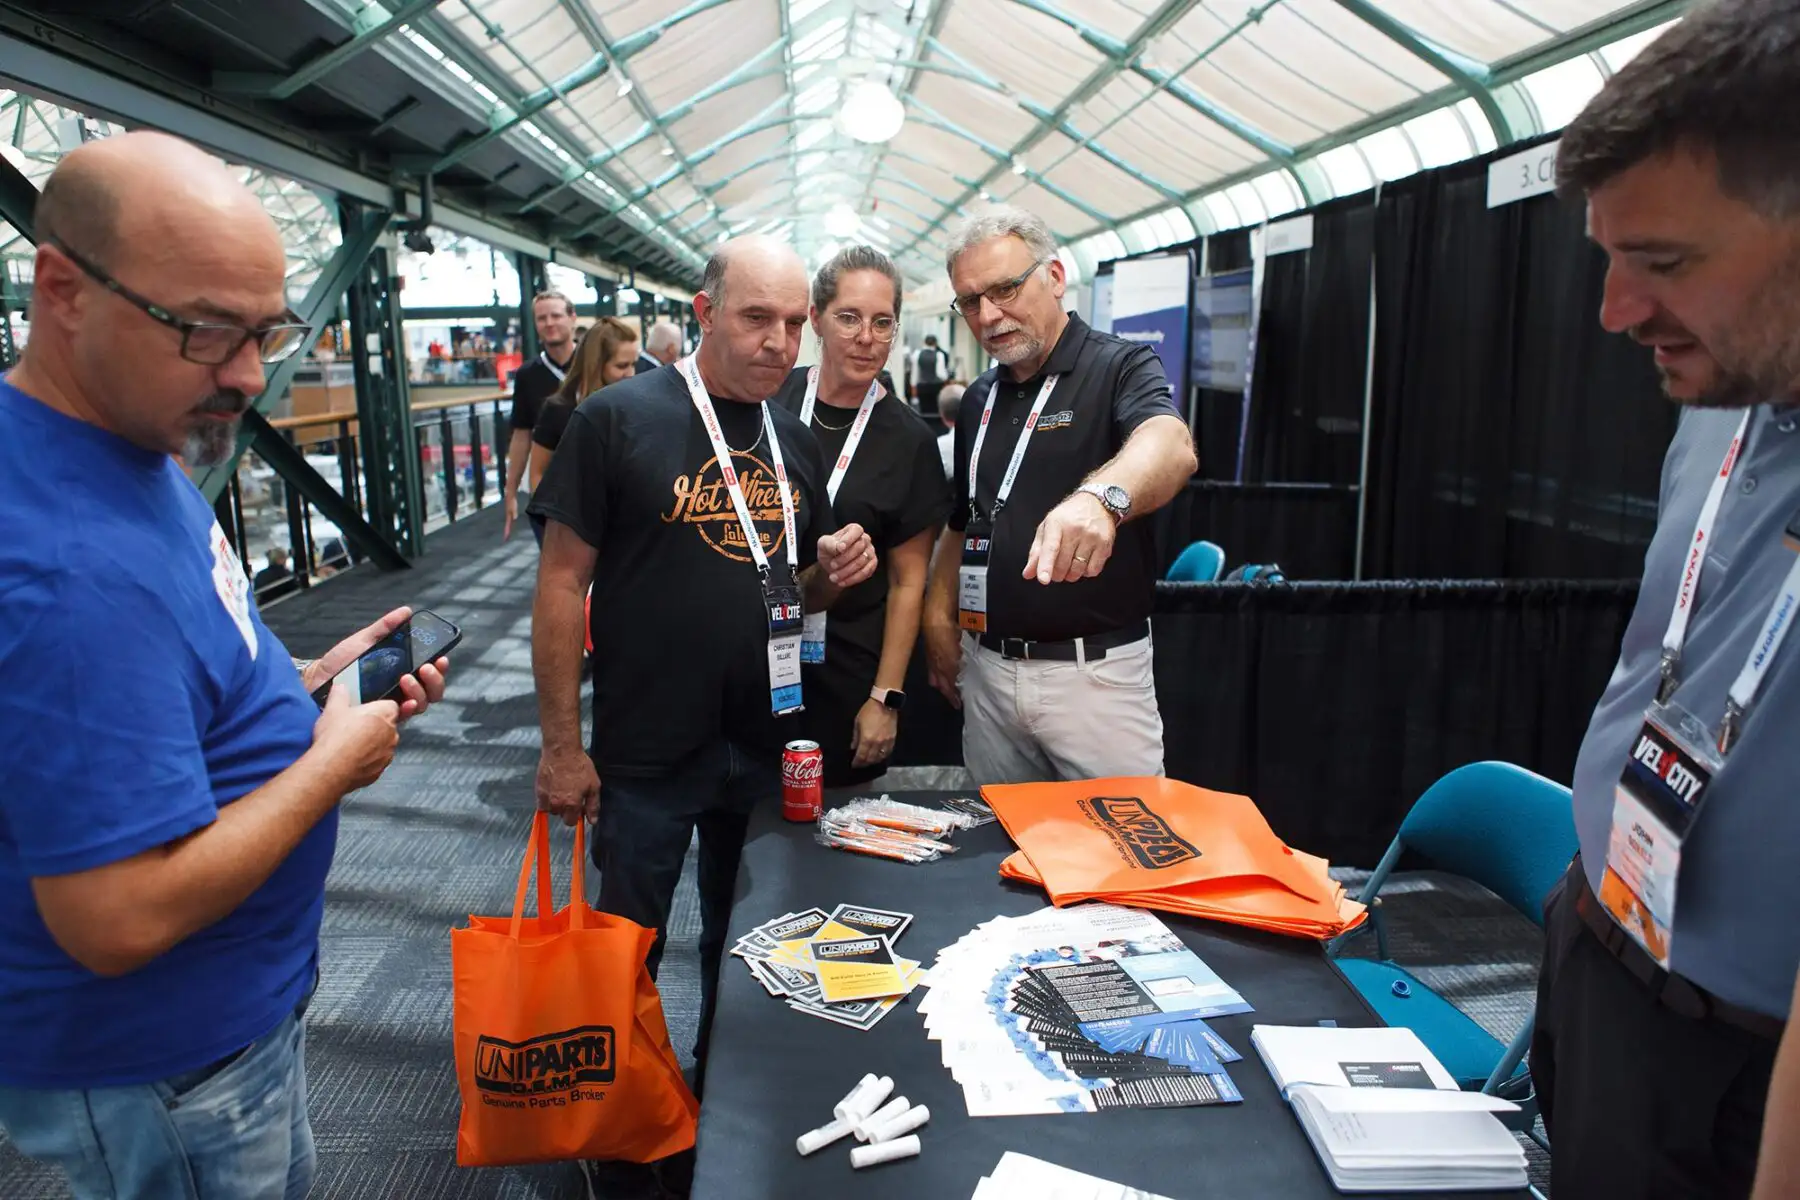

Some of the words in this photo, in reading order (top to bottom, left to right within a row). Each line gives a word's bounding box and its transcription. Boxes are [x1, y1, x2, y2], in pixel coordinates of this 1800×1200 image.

[1521, 164, 1534, 188] 3.
[1006, 453, 1021, 486] AkzoNobel
[661, 474, 728, 522] Hot
[725, 468, 801, 511] Whees
[785, 517, 796, 547] AXALTA
[1679, 548, 1699, 611] AXALTA
[1753, 593, 1795, 672] AkzoNobel
[822, 941, 878, 954] UNIPARTS
[479, 1036, 606, 1081] UNIPARTS
[482, 1093, 526, 1110] Genuine
[529, 1095, 566, 1109] Parts
[570, 1088, 606, 1102] Broker
[512, 1075, 577, 1093] O.E.M.
